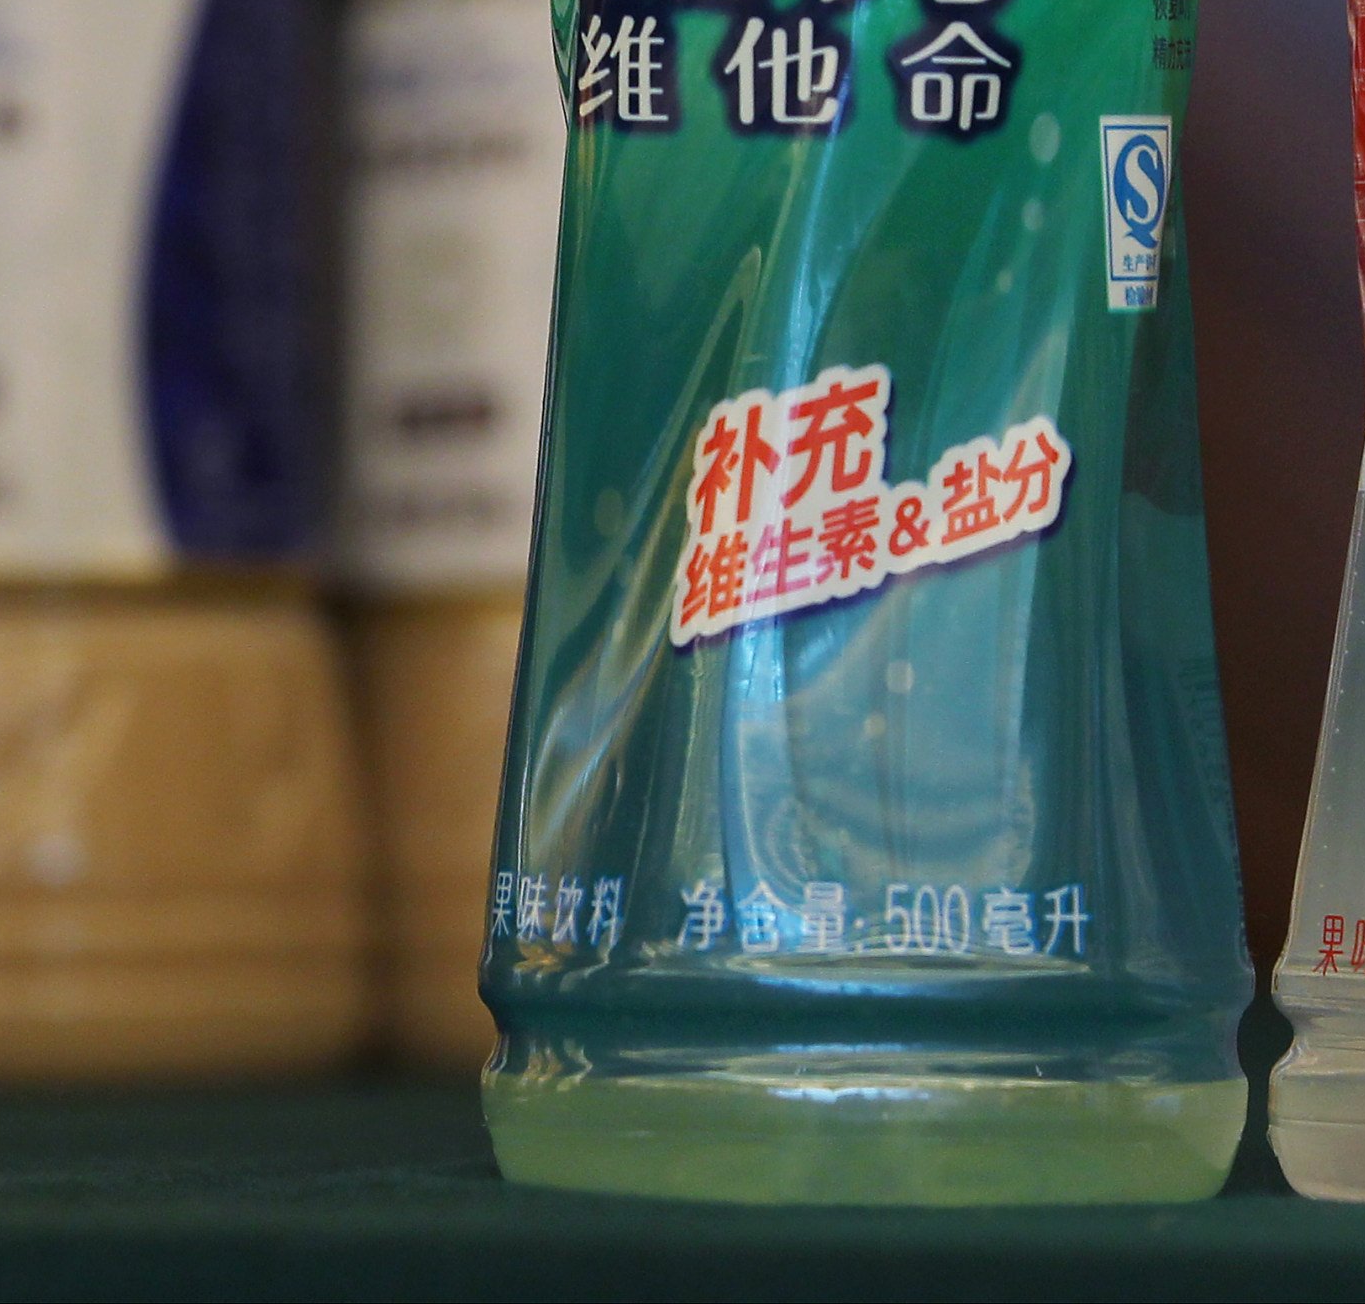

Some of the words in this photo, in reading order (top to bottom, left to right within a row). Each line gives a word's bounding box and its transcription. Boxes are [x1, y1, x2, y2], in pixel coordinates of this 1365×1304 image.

[579, 14, 1012, 130] 维他命
[695, 379, 880, 536] 补充
[492, 871, 624, 946] 果味饮料
[678, 881, 1090, 955] 净含量:500毫升
